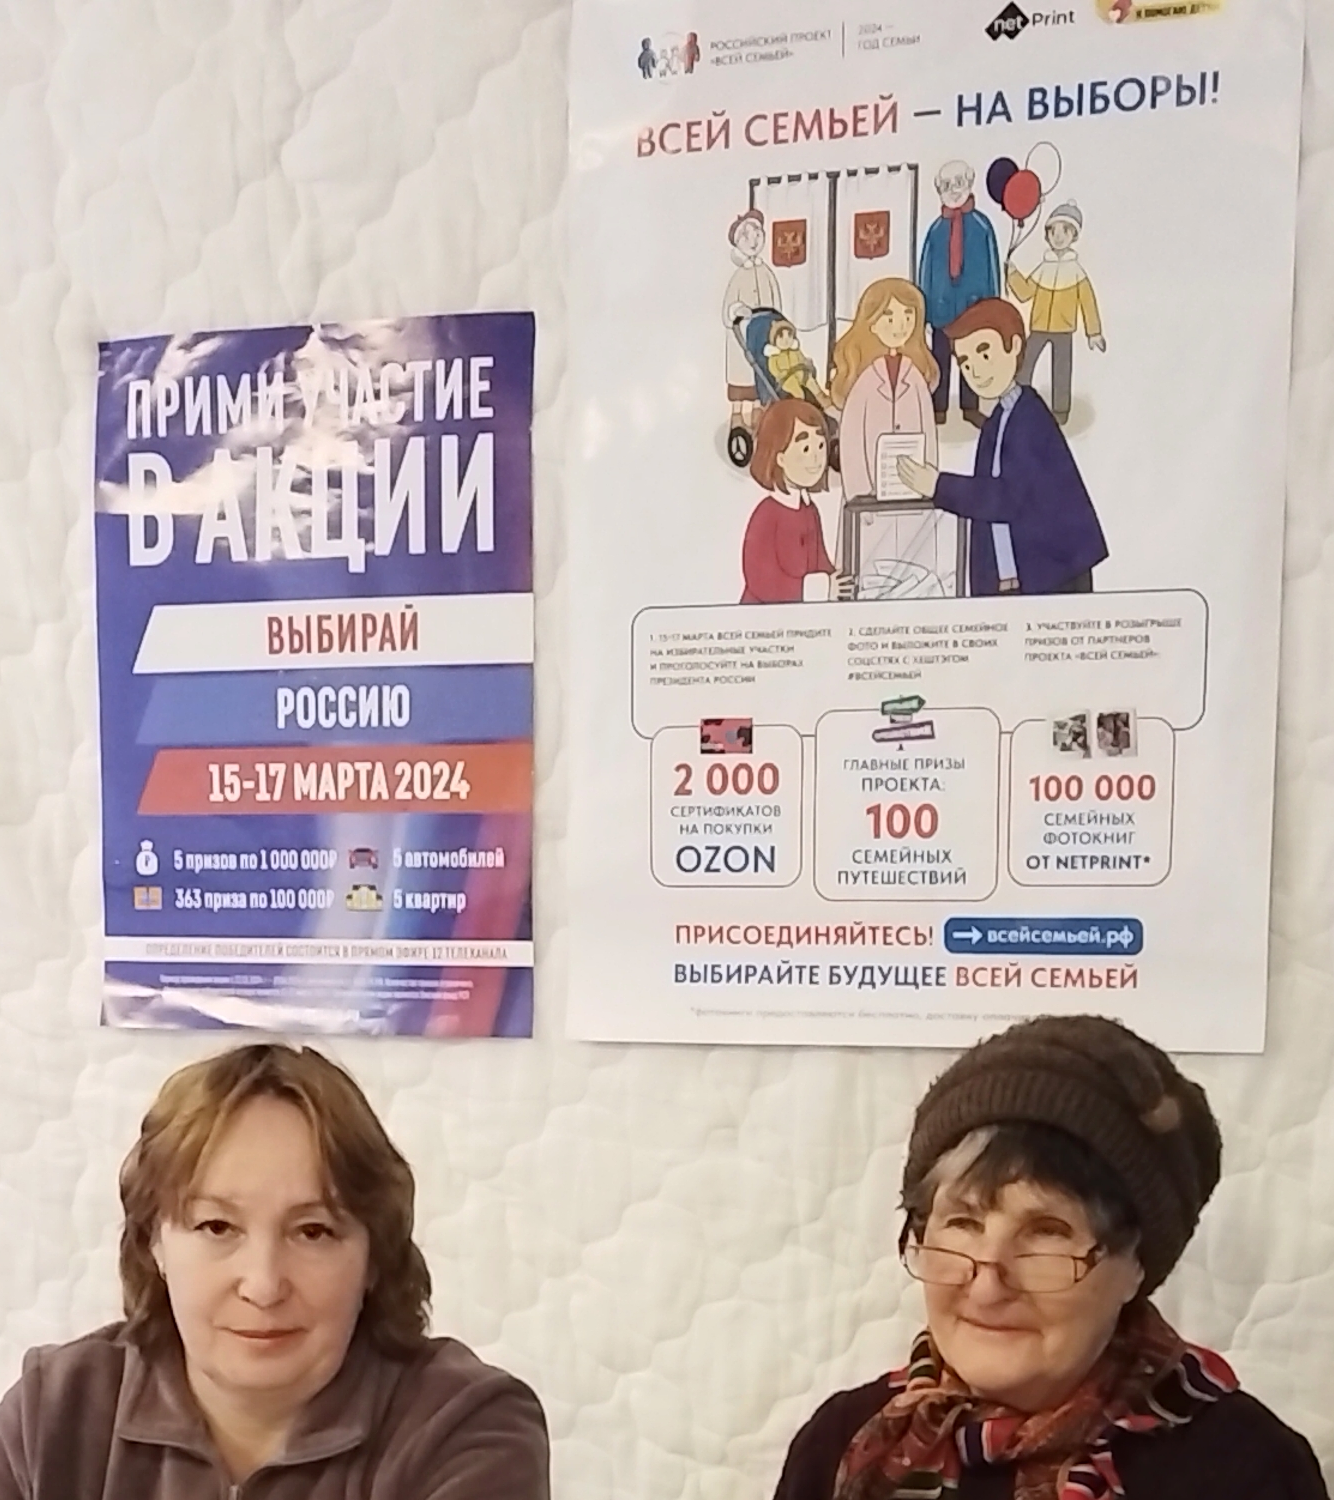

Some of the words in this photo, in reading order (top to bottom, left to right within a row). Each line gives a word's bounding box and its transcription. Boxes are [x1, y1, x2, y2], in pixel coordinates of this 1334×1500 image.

[637, 109, 731, 158] ВСЕЙ
[744, 93, 899, 147] СЕМЬЕЙ
[956, 90, 1013, 127] НА
[1027, 70, 1220, 121] ВЫБОРЫ!
[127, 372, 285, 439] ПРИМИ
[297, 356, 495, 431] УЧАСТИЕ
[128, 453, 174, 567] В
[195, 432, 495, 573] АКЦИИ
[266, 604, 420, 656] ВЫБИРАЙ
[276, 684, 411, 730] РОССИЮ
[843, 758, 910, 771] ГЛАВНЫЕ
[914, 757, 966, 770] ПРИЗЫ
[207, 762, 287, 803] 15-17
[293, 761, 390, 802] МАРТА
[393, 761, 471, 801] 2024
[673, 762, 693, 797] 2
[706, 762, 780, 796] 000
[1028, 774, 1084, 802] 100
[1094, 774, 1157, 802] 000
[670, 805, 782, 818] СЕРТИФИКАТОВ
[865, 803, 939, 840] 100
[1043, 810, 1136, 825] СЕМЕЙНЫХ
[679, 823, 699, 836] НА
[703, 823, 773, 836] ПОКУПКИ
[1042, 832, 1136, 846] ФОТОКНИГ
[173, 849, 184, 871] 5
[185, 853, 238, 874] призов
[239, 853, 258, 870] по
[270, 849, 299, 871] 000
[392, 847, 403, 869] 5
[405, 846, 505, 869] автомобилей
[675, 845, 776, 873] OZON
[851, 846, 953, 865] СЕМЕЙНЫХ
[1025, 856, 1050, 870] ОТ
[837, 867, 967, 886] ПУТЕШЕСТВИЙ
[174, 888, 203, 909] 363
[204, 891, 247, 913] приза
[249, 892, 268, 909] по
[269, 888, 296, 910] 100
[393, 888, 403, 910] 5
[405, 892, 467, 914] квартир
[675, 921, 934, 949] ПРИСОЕДИНЯЙТЕСЬ!
[987, 925, 1135, 949] всейсемьей.рф
[673, 960, 821, 985] ВЫБИРАЙТЕ
[828, 964, 947, 990] БУДУЩЕЕ
[955, 961, 1022, 988] ВСЕЙ
[1030, 962, 1138, 989] СЕМЬЕЙ
